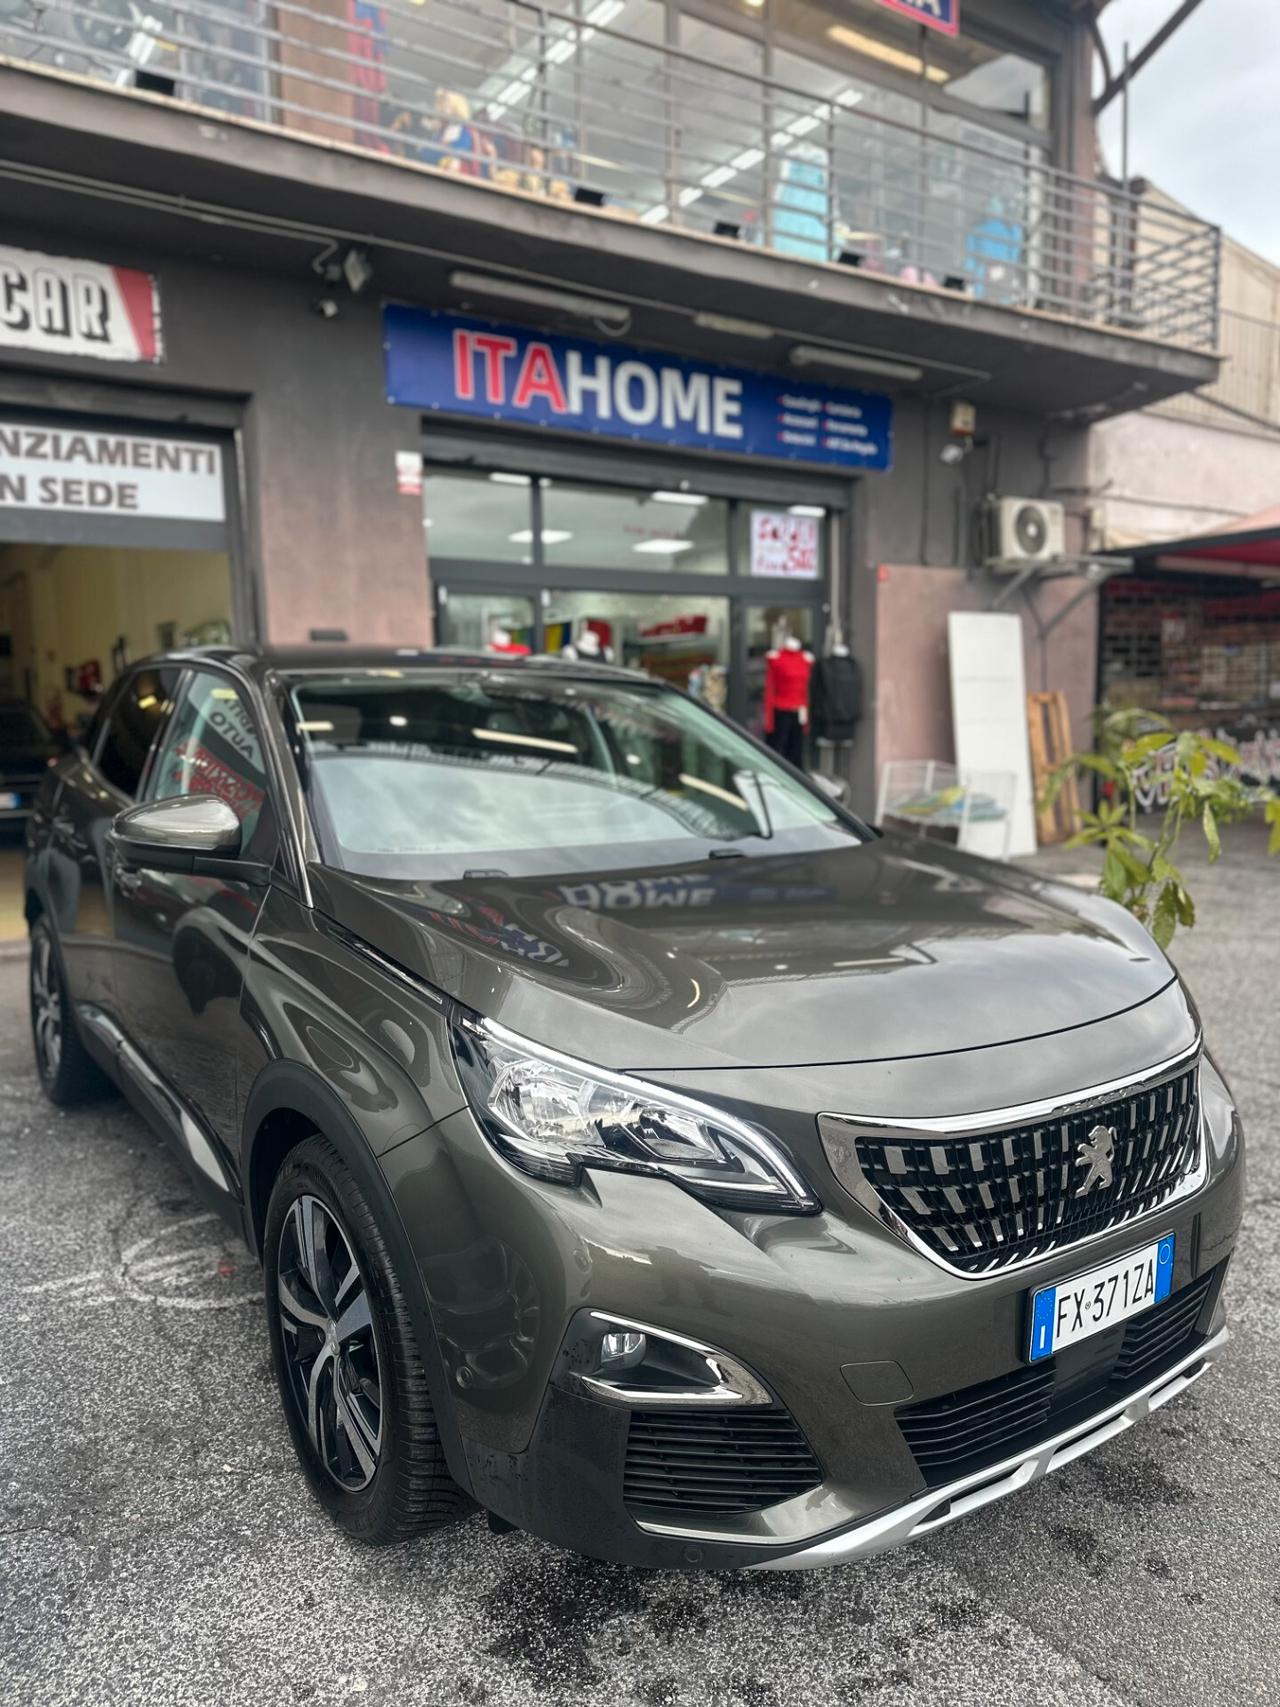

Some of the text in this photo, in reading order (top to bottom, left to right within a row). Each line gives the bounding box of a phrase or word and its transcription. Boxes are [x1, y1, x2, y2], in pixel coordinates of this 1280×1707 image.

[0, 261, 110, 344] CAR
[453, 329, 744, 440] ITAHOME
[38, 475, 139, 510] SEDE
